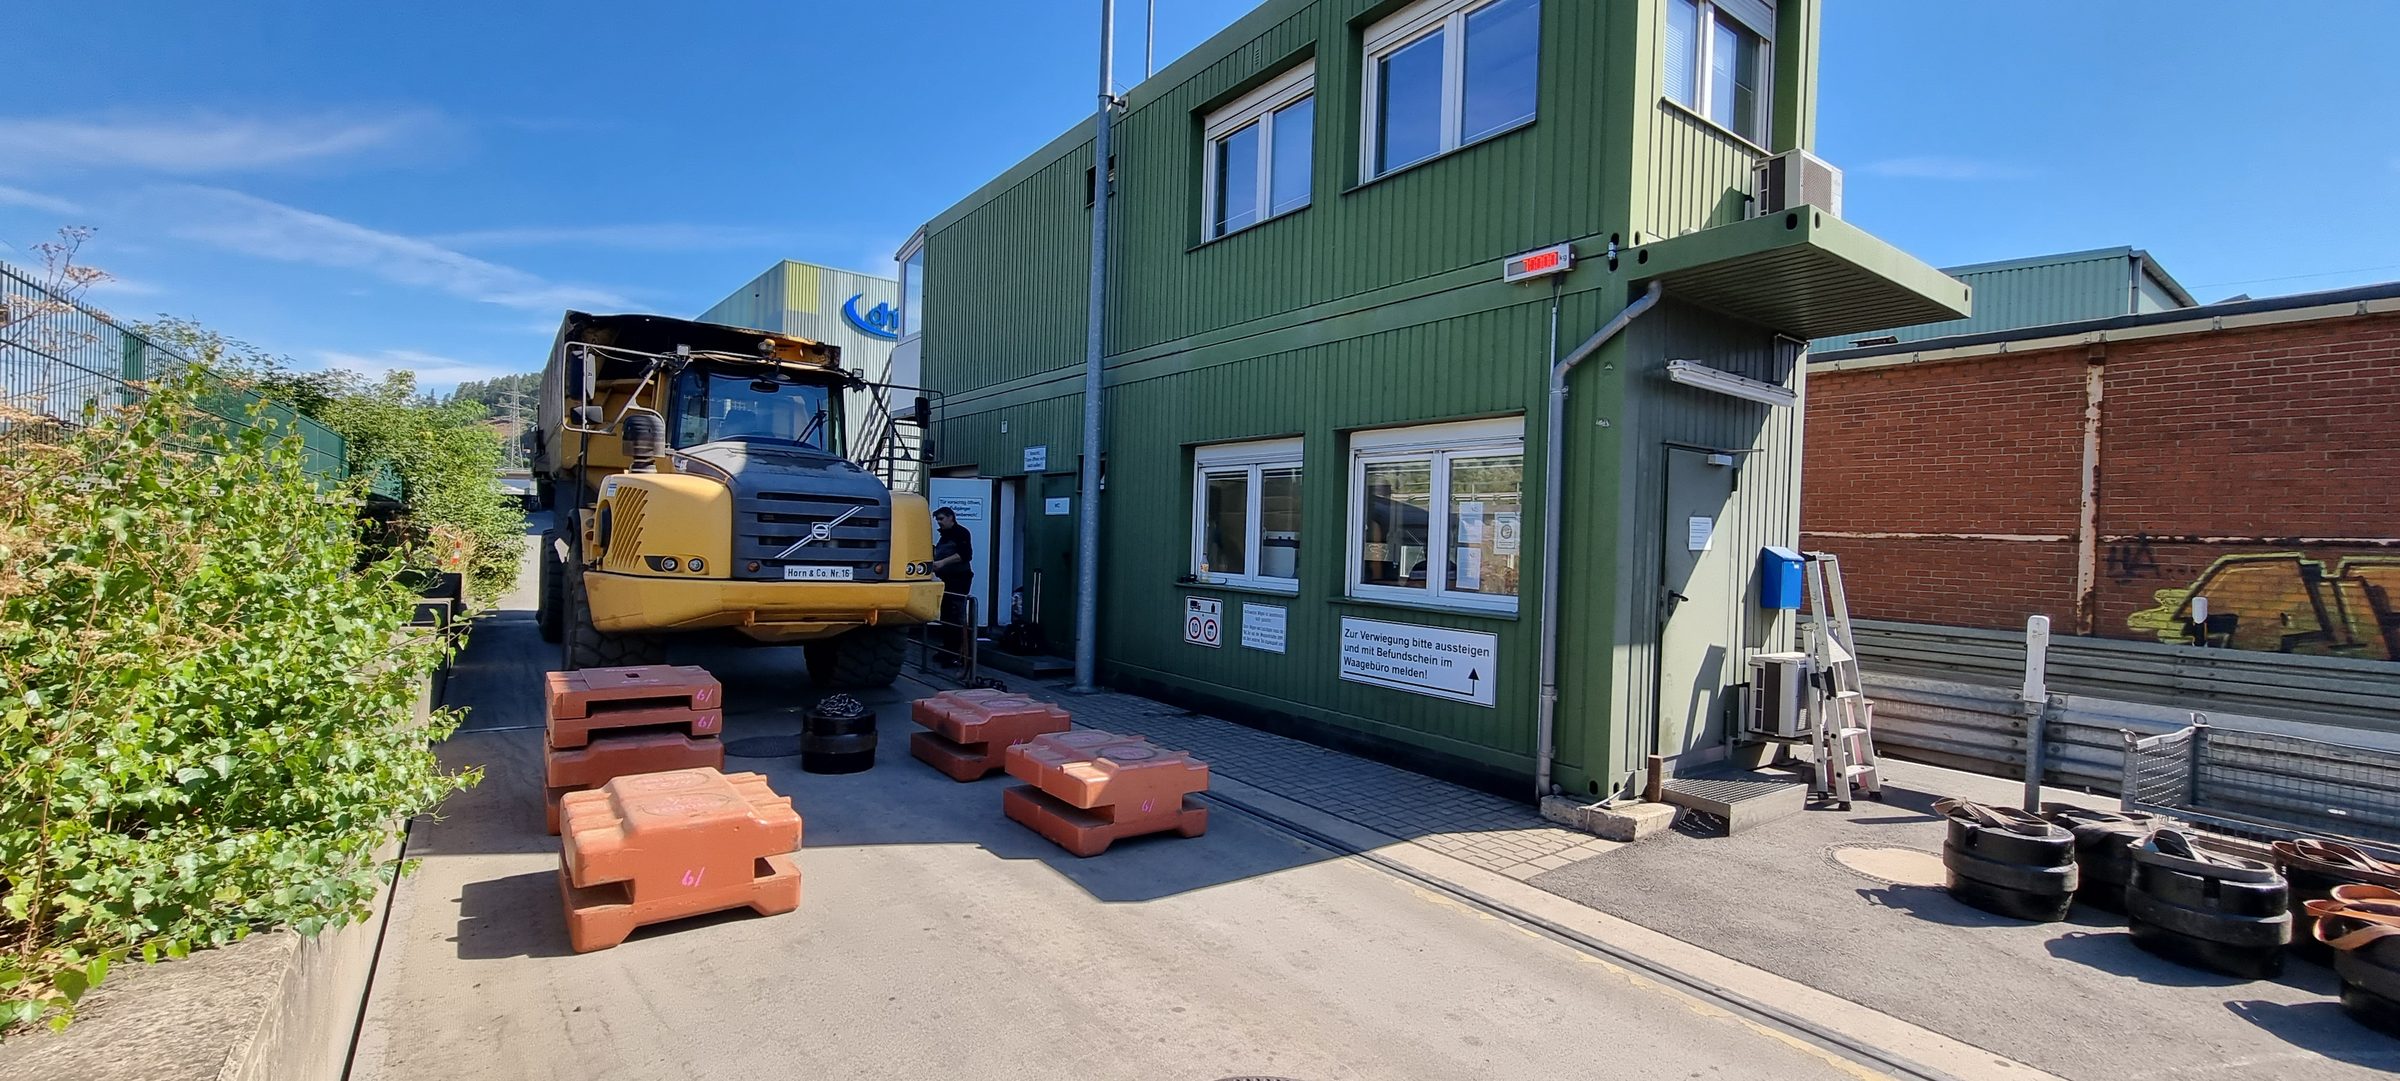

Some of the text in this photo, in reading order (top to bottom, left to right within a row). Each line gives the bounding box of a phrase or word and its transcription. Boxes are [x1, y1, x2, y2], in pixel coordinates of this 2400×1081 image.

[788, 568, 807, 577] Horn
[809, 569, 814, 577] &
[1344, 628, 1490, 658] Zur Verwiegung bitte aussteigen
[1343, 656, 1428, 680] Waagebüro melden!
[1344, 644, 1453, 668] und mit Befundschein im
